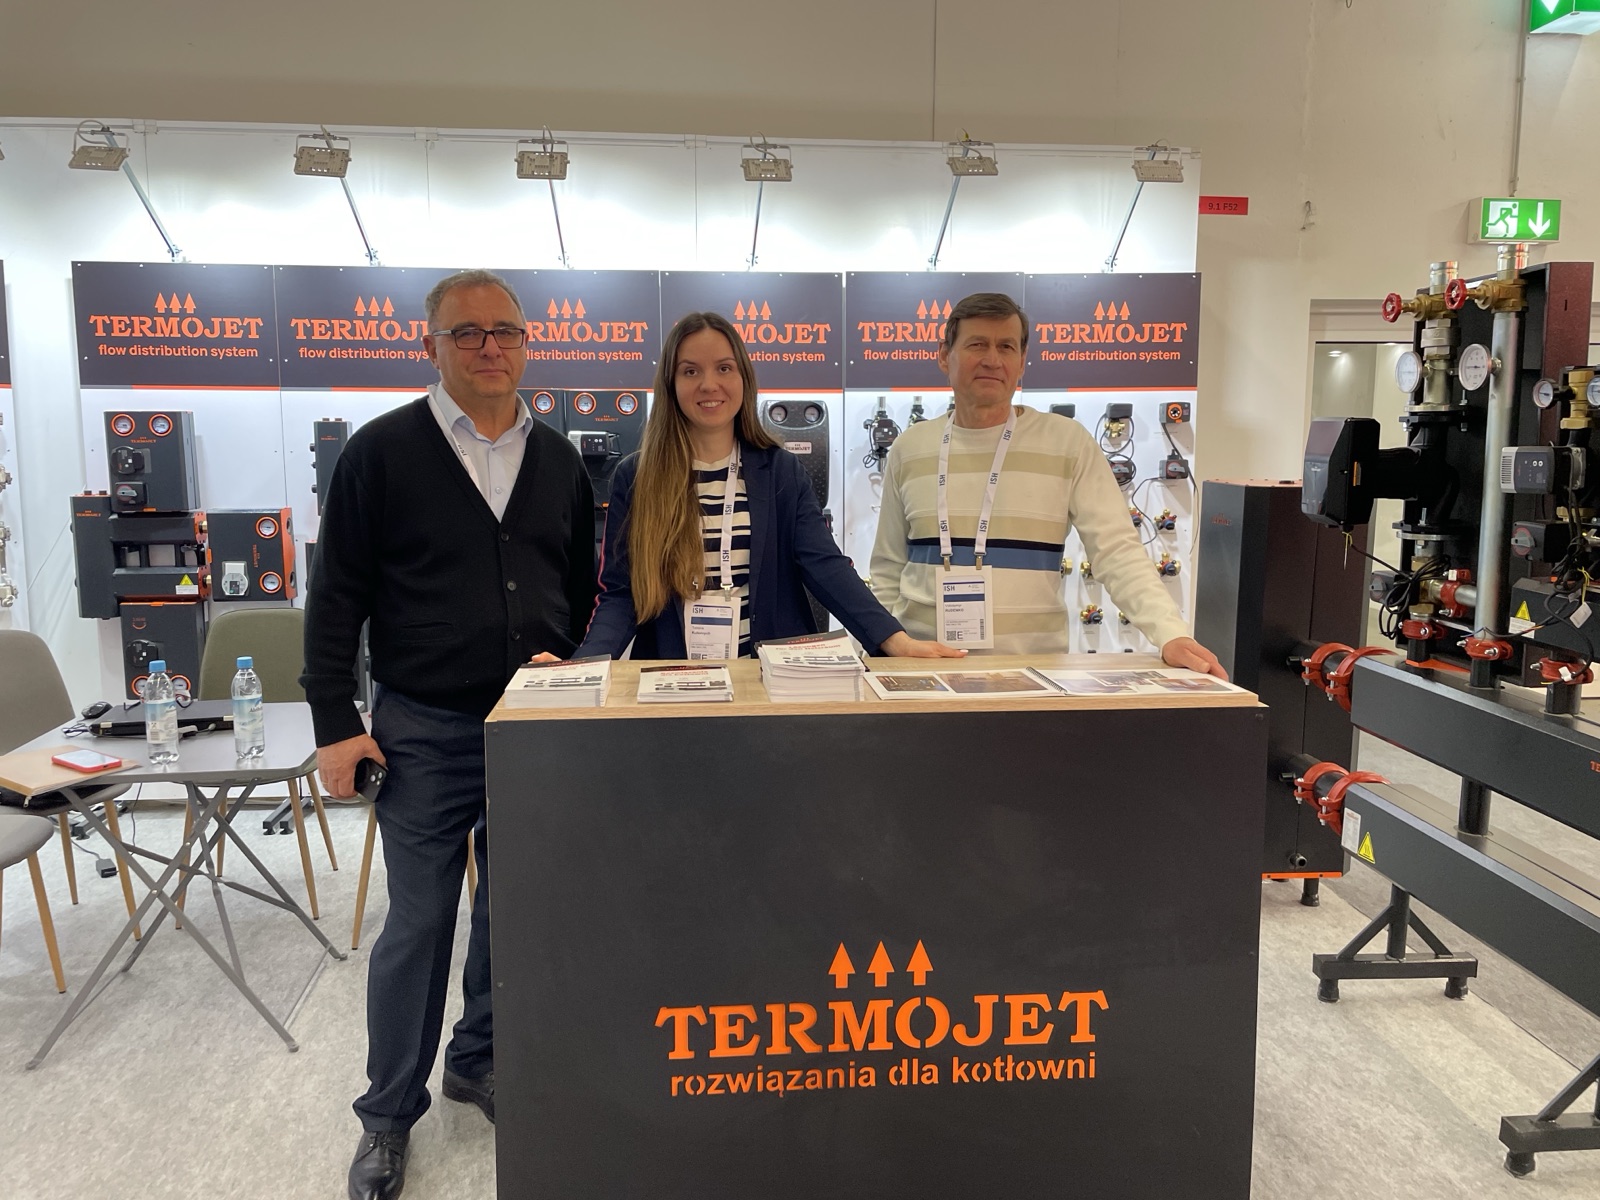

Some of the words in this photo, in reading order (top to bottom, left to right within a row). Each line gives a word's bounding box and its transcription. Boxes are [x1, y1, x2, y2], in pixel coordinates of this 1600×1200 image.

[1208, 202, 1221, 211] 9.1
[1223, 202, 1238, 211] F52
[88, 314, 263, 339] TERMOJET
[291, 317, 428, 341] TERMOJ
[526, 321, 648, 343] RMOJET
[732, 322, 832, 344] MOJET
[1035, 322, 1188, 344] TERMOJET
[98, 343, 126, 356] flow
[129, 344, 208, 358] distribution
[210, 346, 258, 359] system
[298, 346, 326, 358] flow
[328, 347, 405, 360] distribution
[408, 350, 429, 362] sys
[598, 350, 643, 364] system
[781, 351, 826, 364] system
[864, 348, 889, 360] flow
[1041, 348, 1067, 361] flow
[1068, 349, 1138, 362] distribution
[1139, 350, 1181, 364] system
[1003, 429, 1012, 441] ISH
[990, 472, 998, 485] ISH
[940, 520, 948, 532] ISH
[980, 519, 988, 532] ISH
[722, 550, 730, 562] ISH
[654, 990, 1109, 1060] TERMOJET
[670, 1060, 877, 1098] rozwiązania
[889, 1057, 939, 1086] dla
[952, 1051, 1096, 1084] kotłowni
